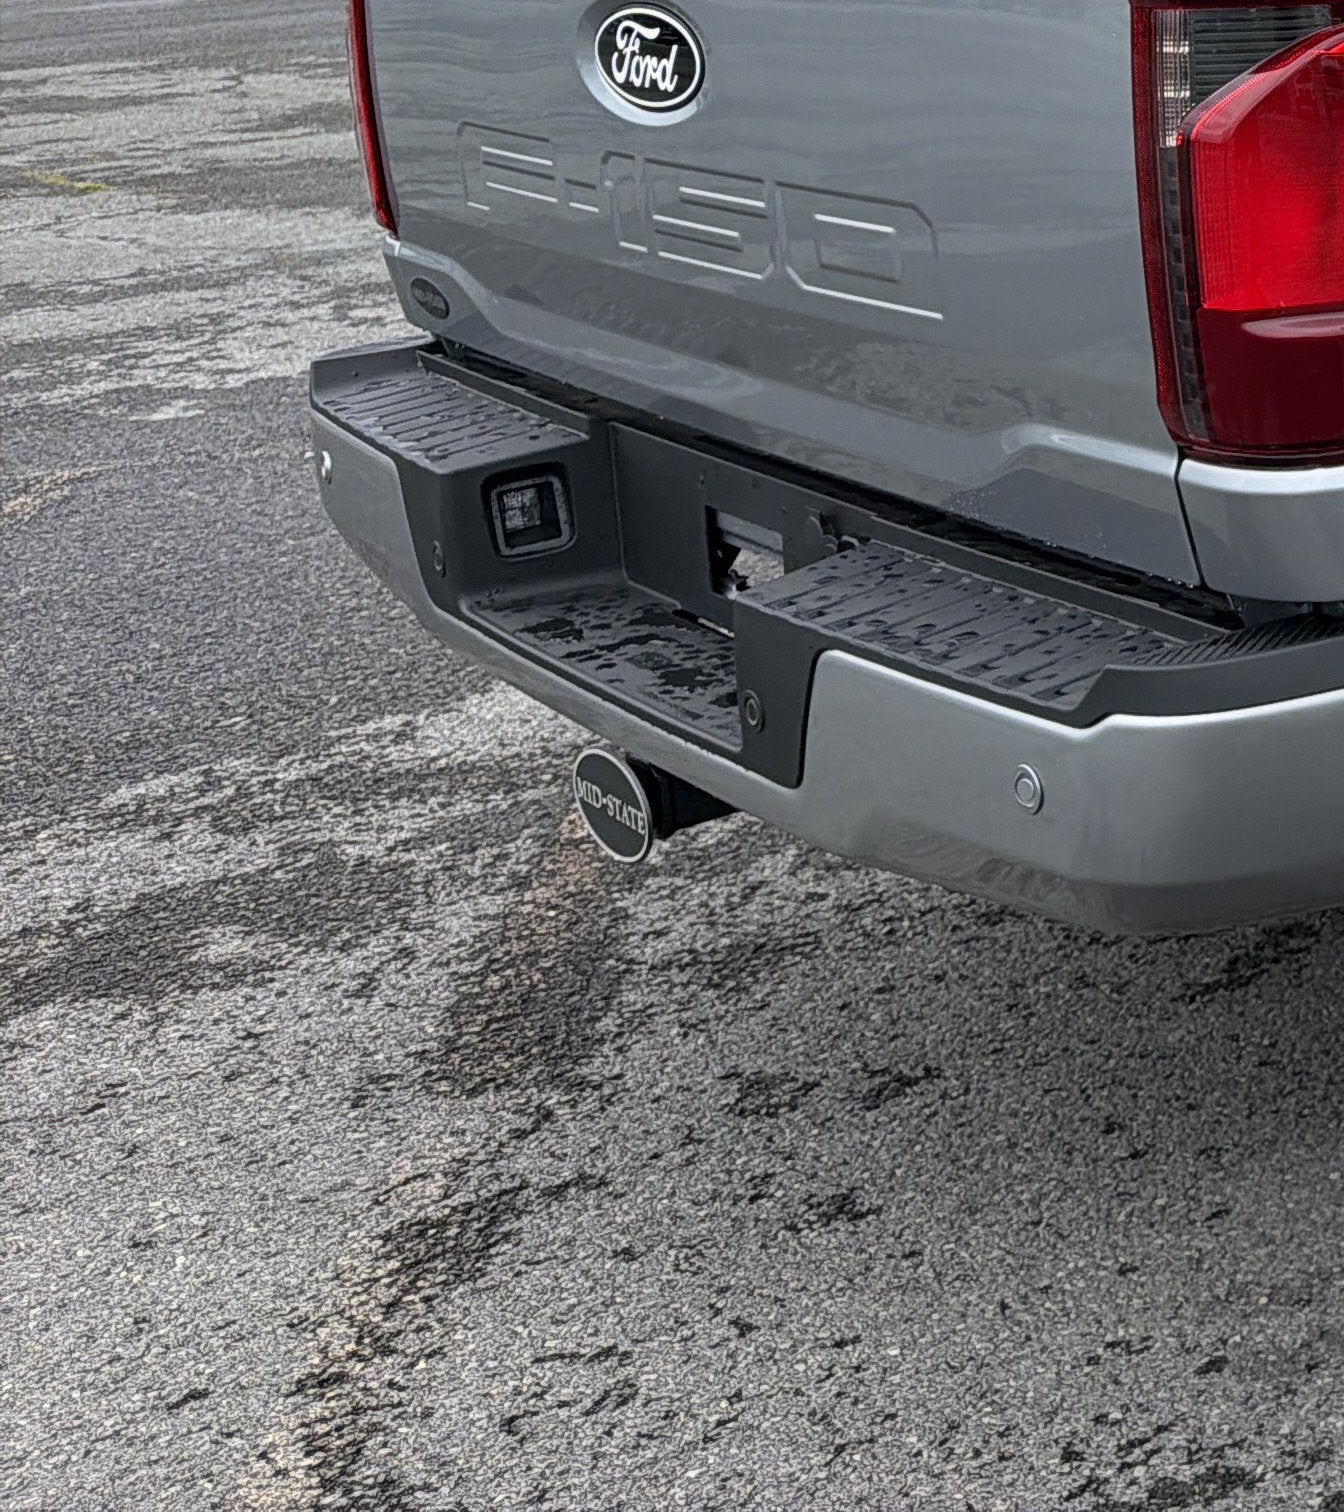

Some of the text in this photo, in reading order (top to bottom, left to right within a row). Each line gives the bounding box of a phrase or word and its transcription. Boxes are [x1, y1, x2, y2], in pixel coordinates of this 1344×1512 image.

[612, 20, 678, 92] Ford
[456, 121, 943, 319] F-150
[576, 776, 646, 837] MID-STATE
